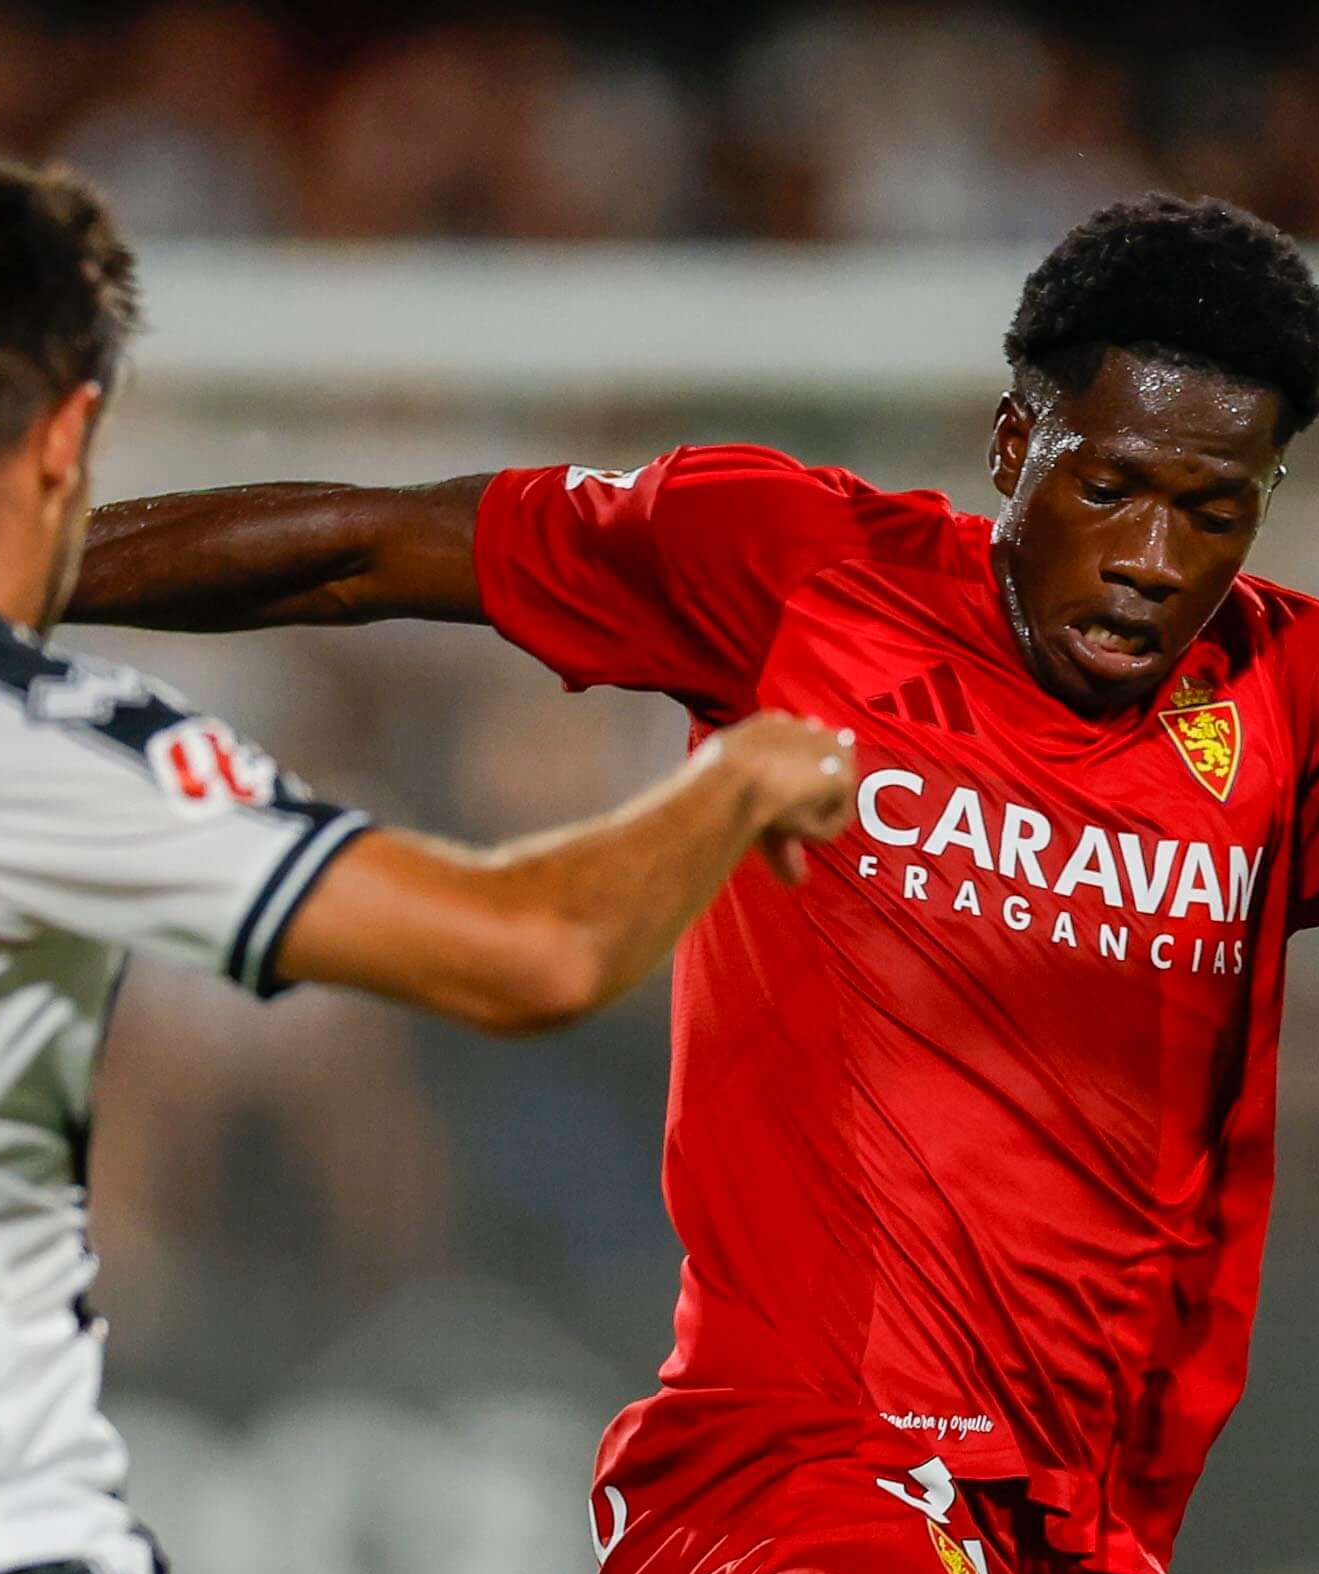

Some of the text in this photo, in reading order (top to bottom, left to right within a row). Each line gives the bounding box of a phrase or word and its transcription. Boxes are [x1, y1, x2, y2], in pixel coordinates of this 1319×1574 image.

[857, 769, 1263, 923] CARAVAN
[859, 855, 1243, 975] FRAGANCIAS
[937, 1417, 948, 1440] y
[950, 1415, 994, 1440] Orgullo
